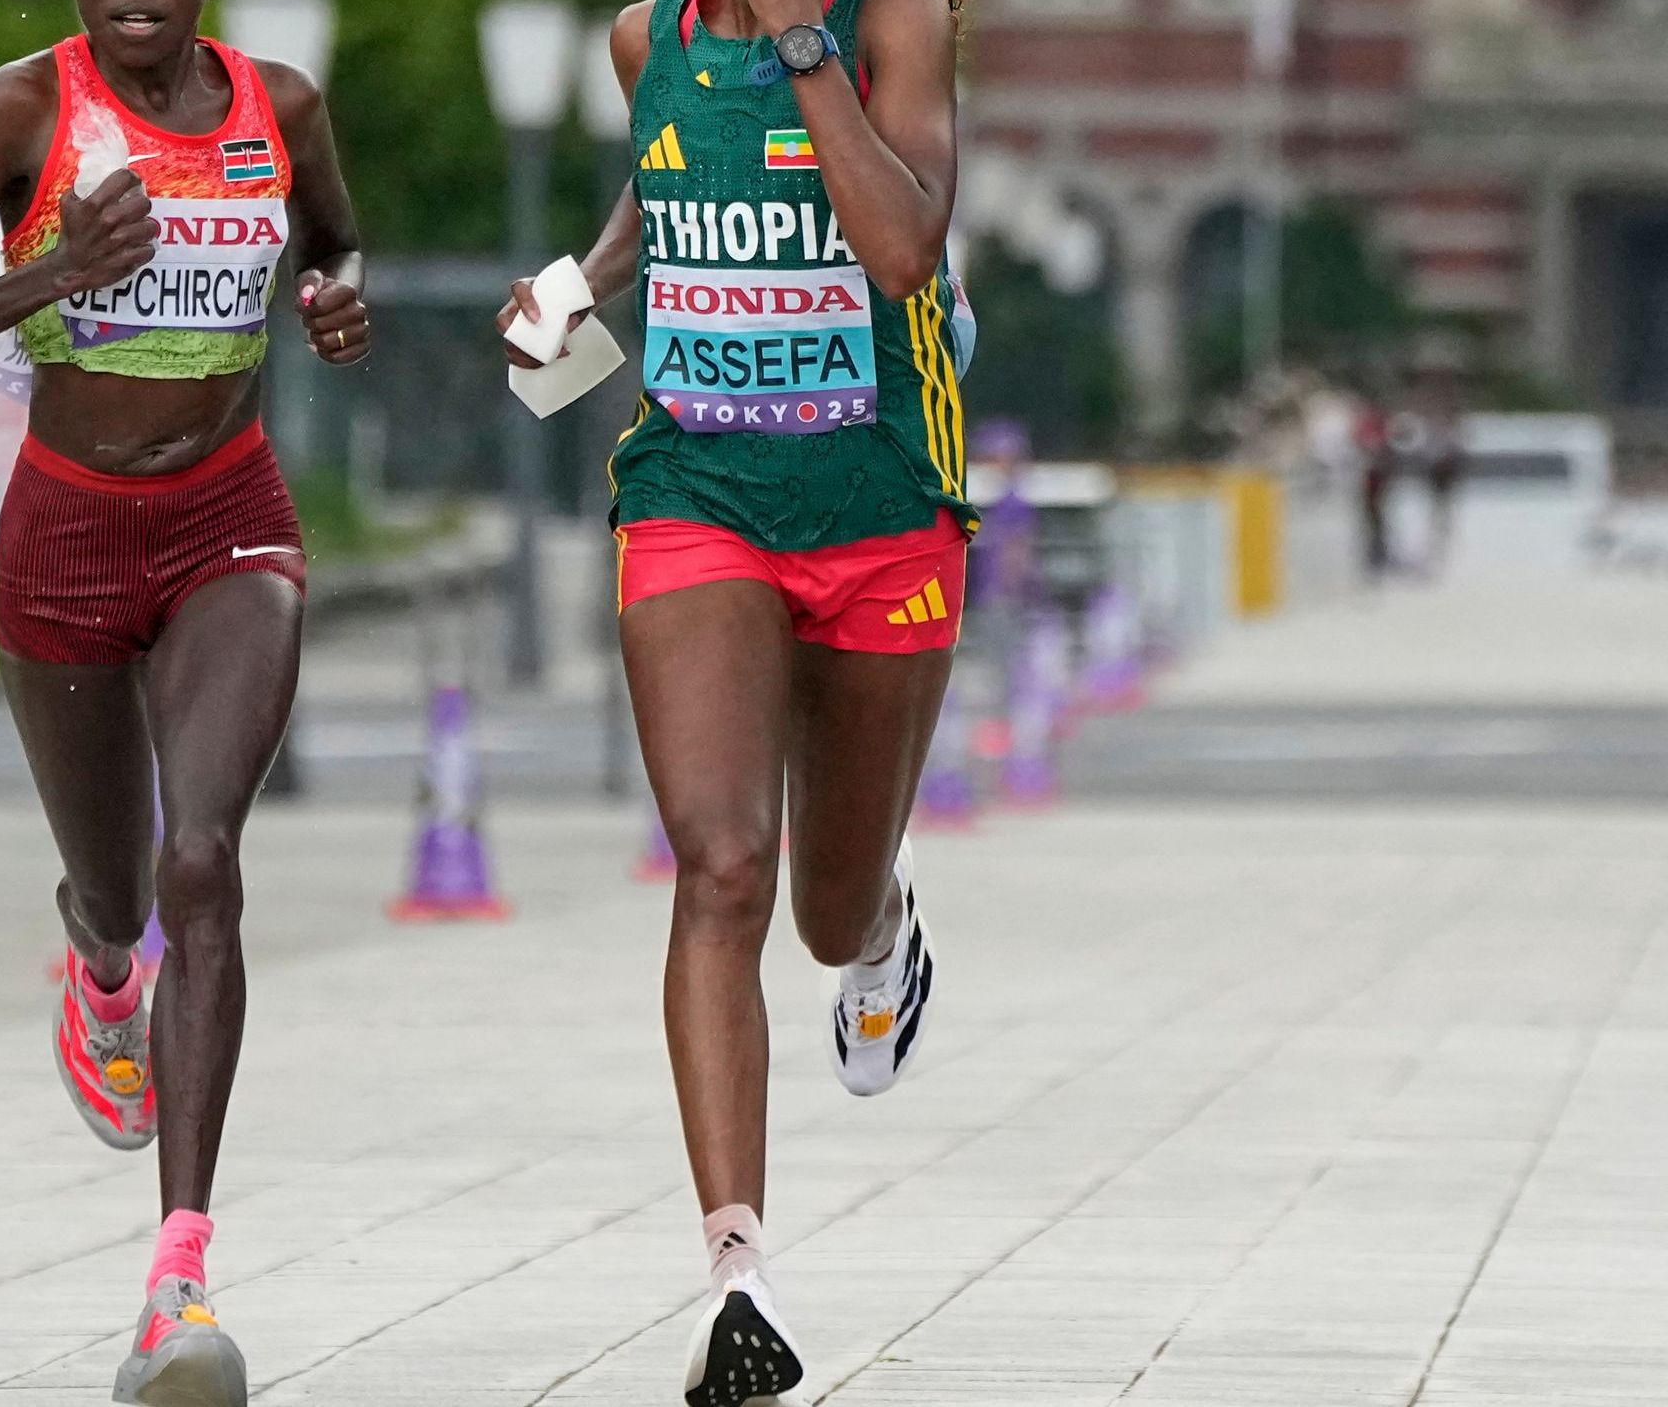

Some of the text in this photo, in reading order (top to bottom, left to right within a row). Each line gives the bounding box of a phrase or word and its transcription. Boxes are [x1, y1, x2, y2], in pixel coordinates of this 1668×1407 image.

[153, 216, 283, 246] NDA
[651, 281, 864, 315] HONDA
[653, 334, 861, 389] ASSEFA
